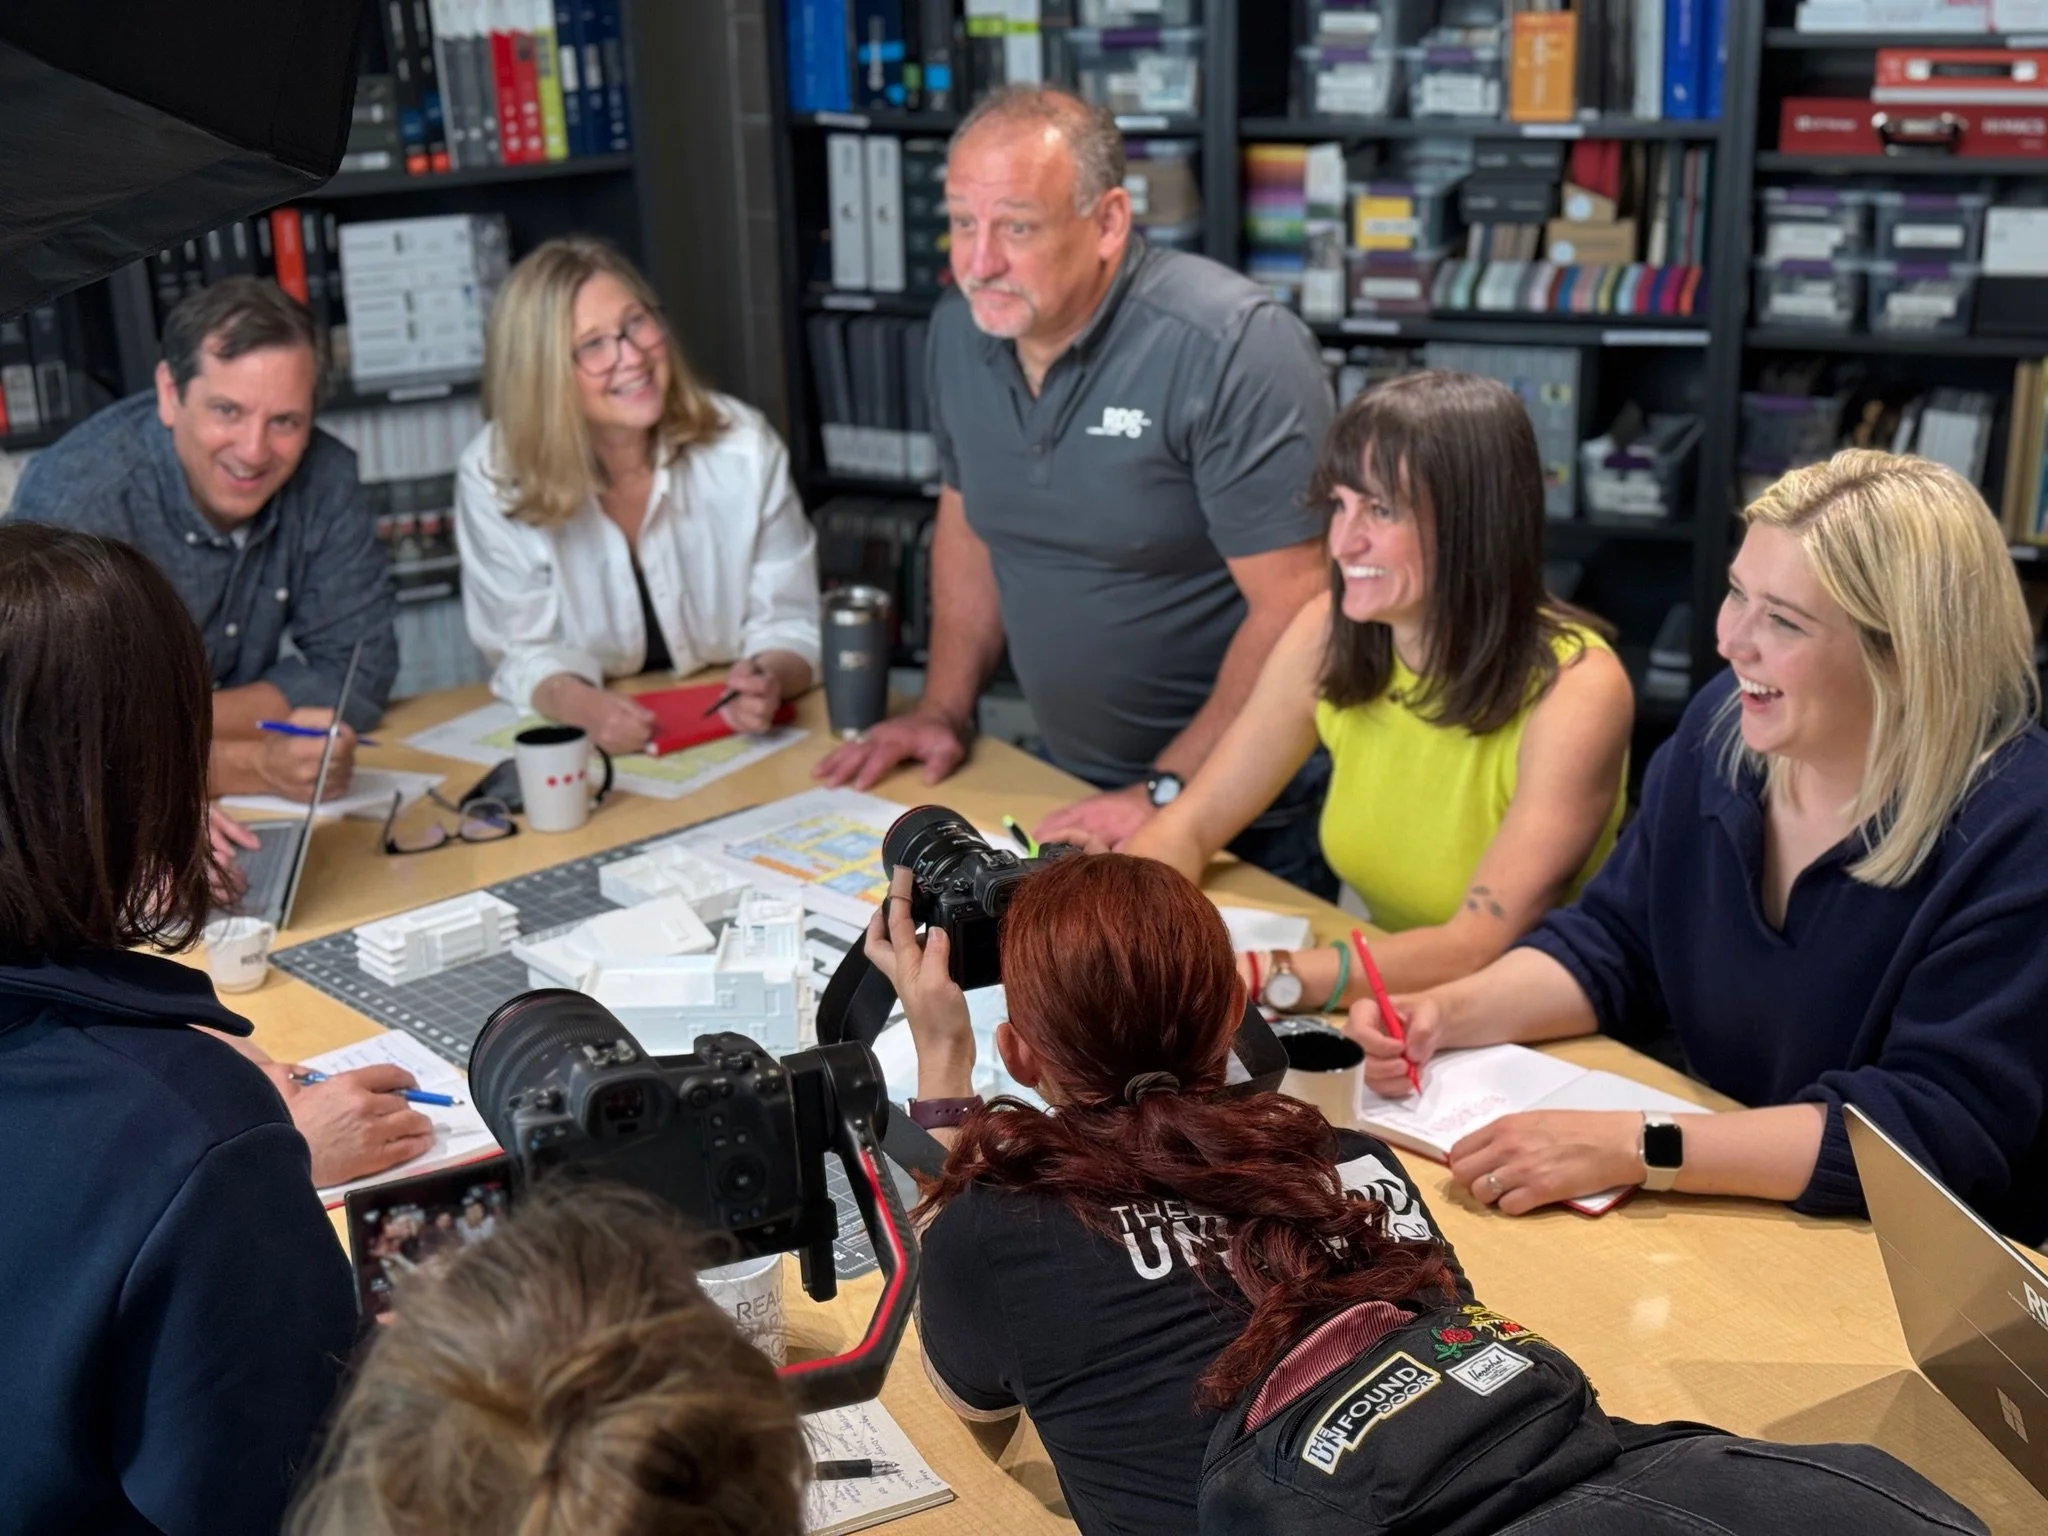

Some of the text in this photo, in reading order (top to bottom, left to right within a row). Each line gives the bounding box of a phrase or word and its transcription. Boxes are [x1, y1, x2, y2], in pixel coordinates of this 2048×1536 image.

[1110, 1199, 1194, 1233] THE
[1375, 1375, 1434, 1413] DOOR
[1318, 1367, 1418, 1465] UNFOUND
[1307, 1427, 1330, 1458] THE
